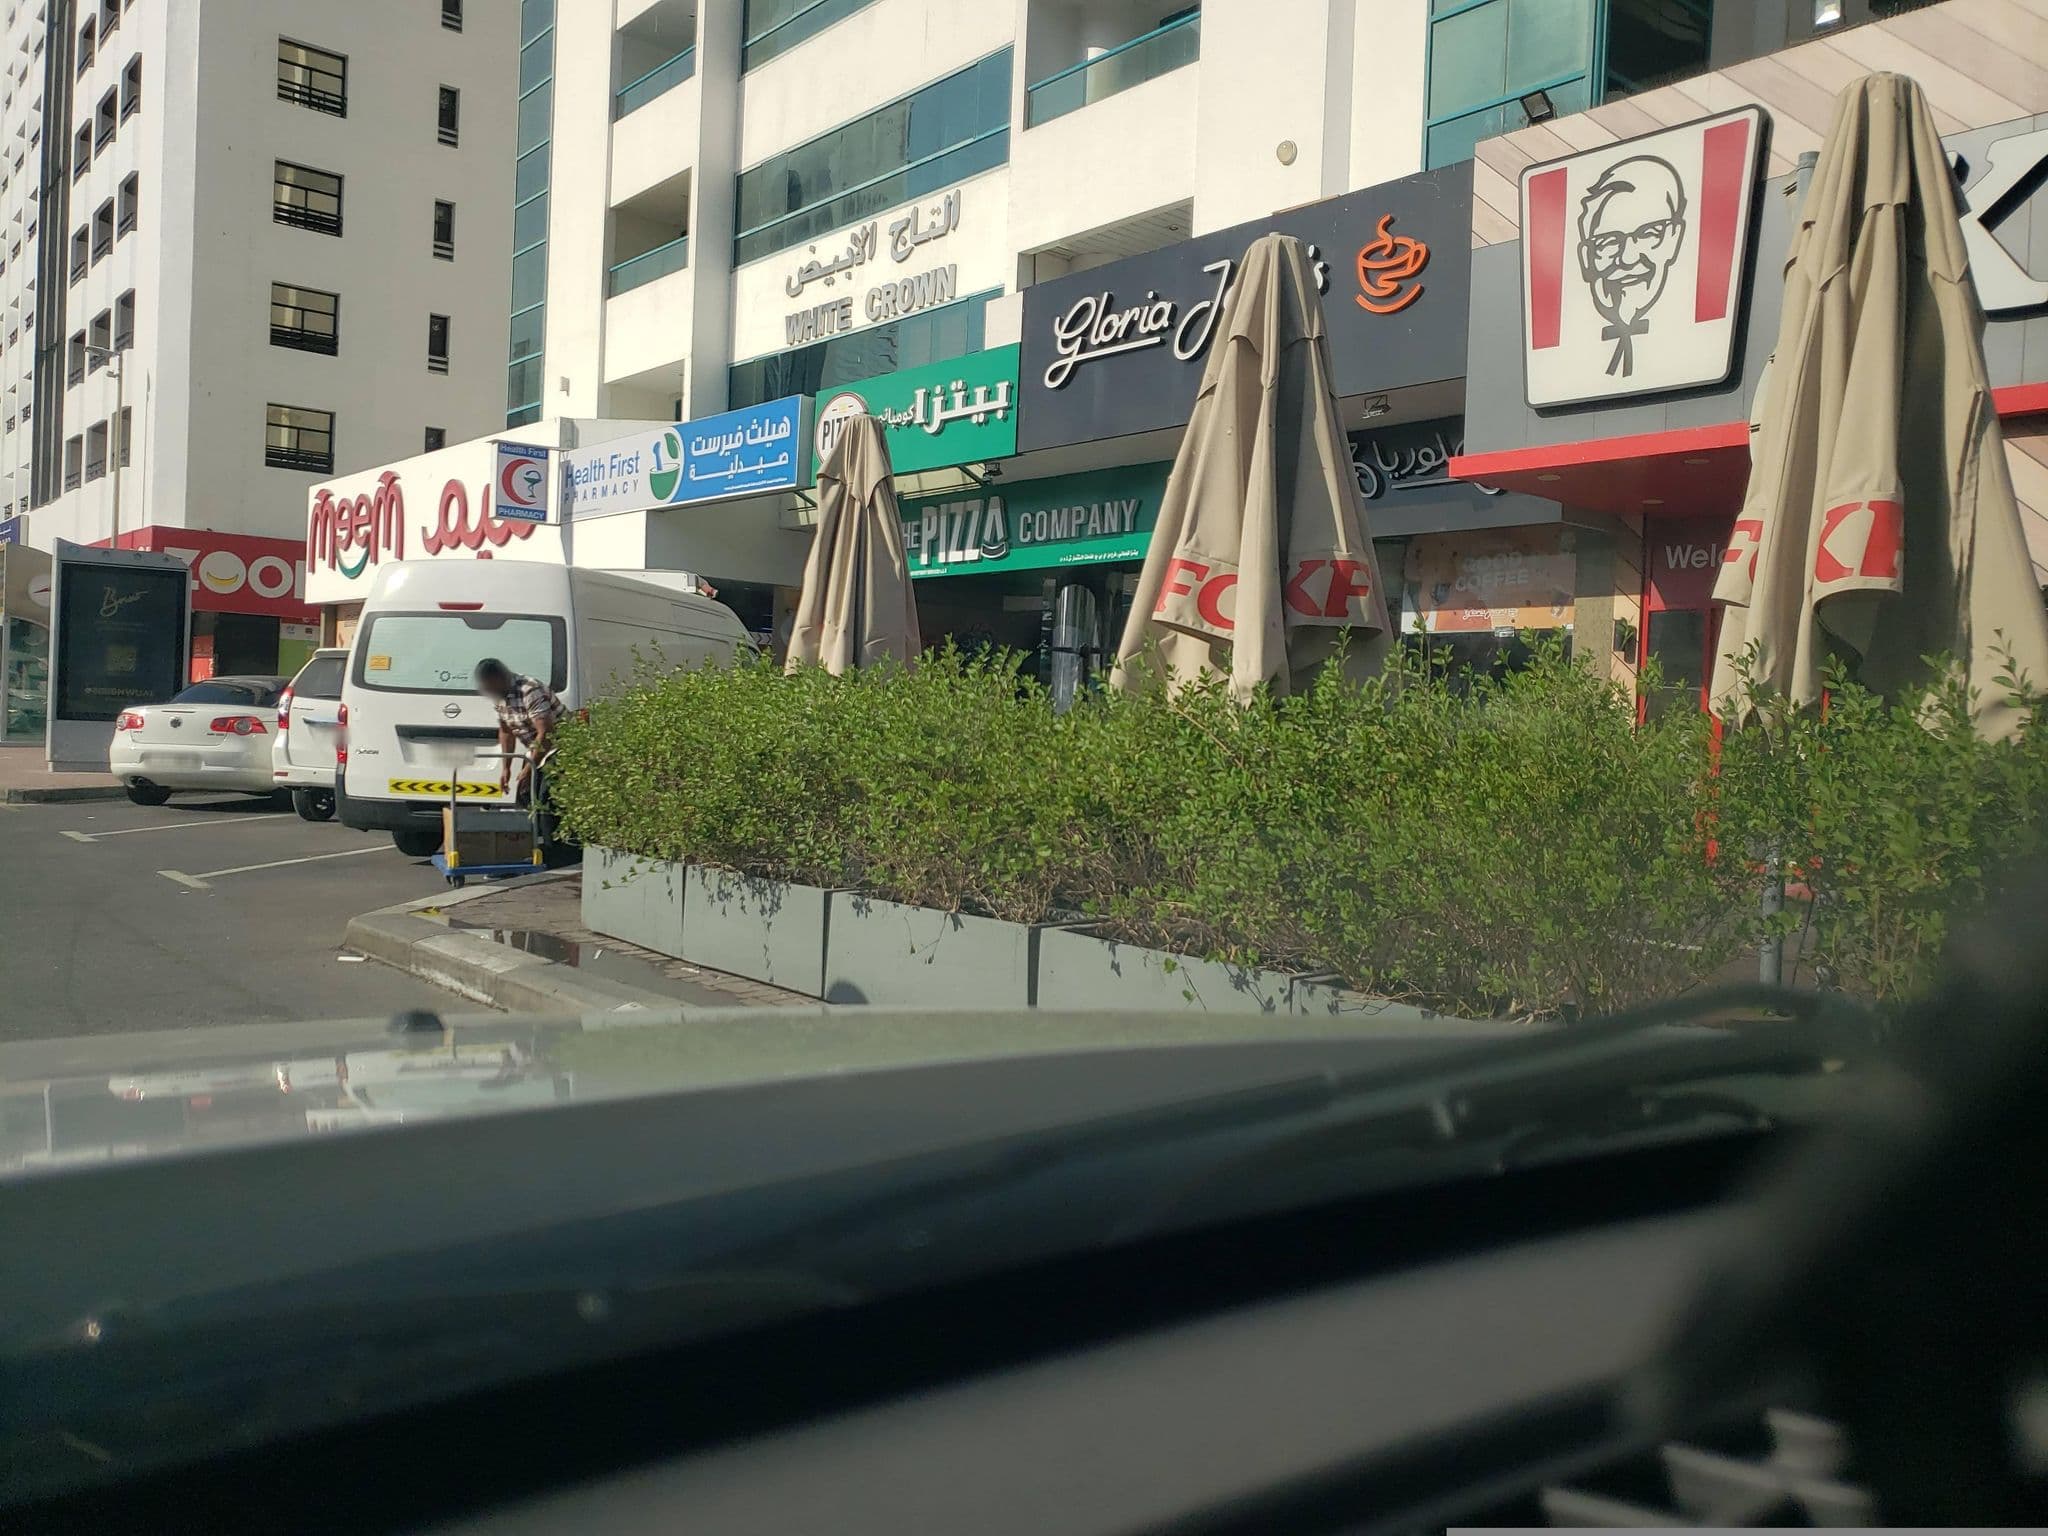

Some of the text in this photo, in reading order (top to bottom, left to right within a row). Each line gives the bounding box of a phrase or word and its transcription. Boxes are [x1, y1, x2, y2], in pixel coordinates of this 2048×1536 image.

[889, 189, 961, 263] التاج
[785, 264, 957, 346] WHITE CROWN
[1044, 291, 1175, 389] Gloria
[915, 380, 1012, 434] بيتزا
[500, 444, 547, 458] Health First
[690, 415, 791, 457] هيلث فيرست
[565, 451, 641, 488] Health First
[565, 479, 640, 503] PHARMACY
[498, 507, 545, 520] PHARMACY
[920, 497, 1007, 565] PIZZA
[1019, 500, 1137, 543] COMPANY
